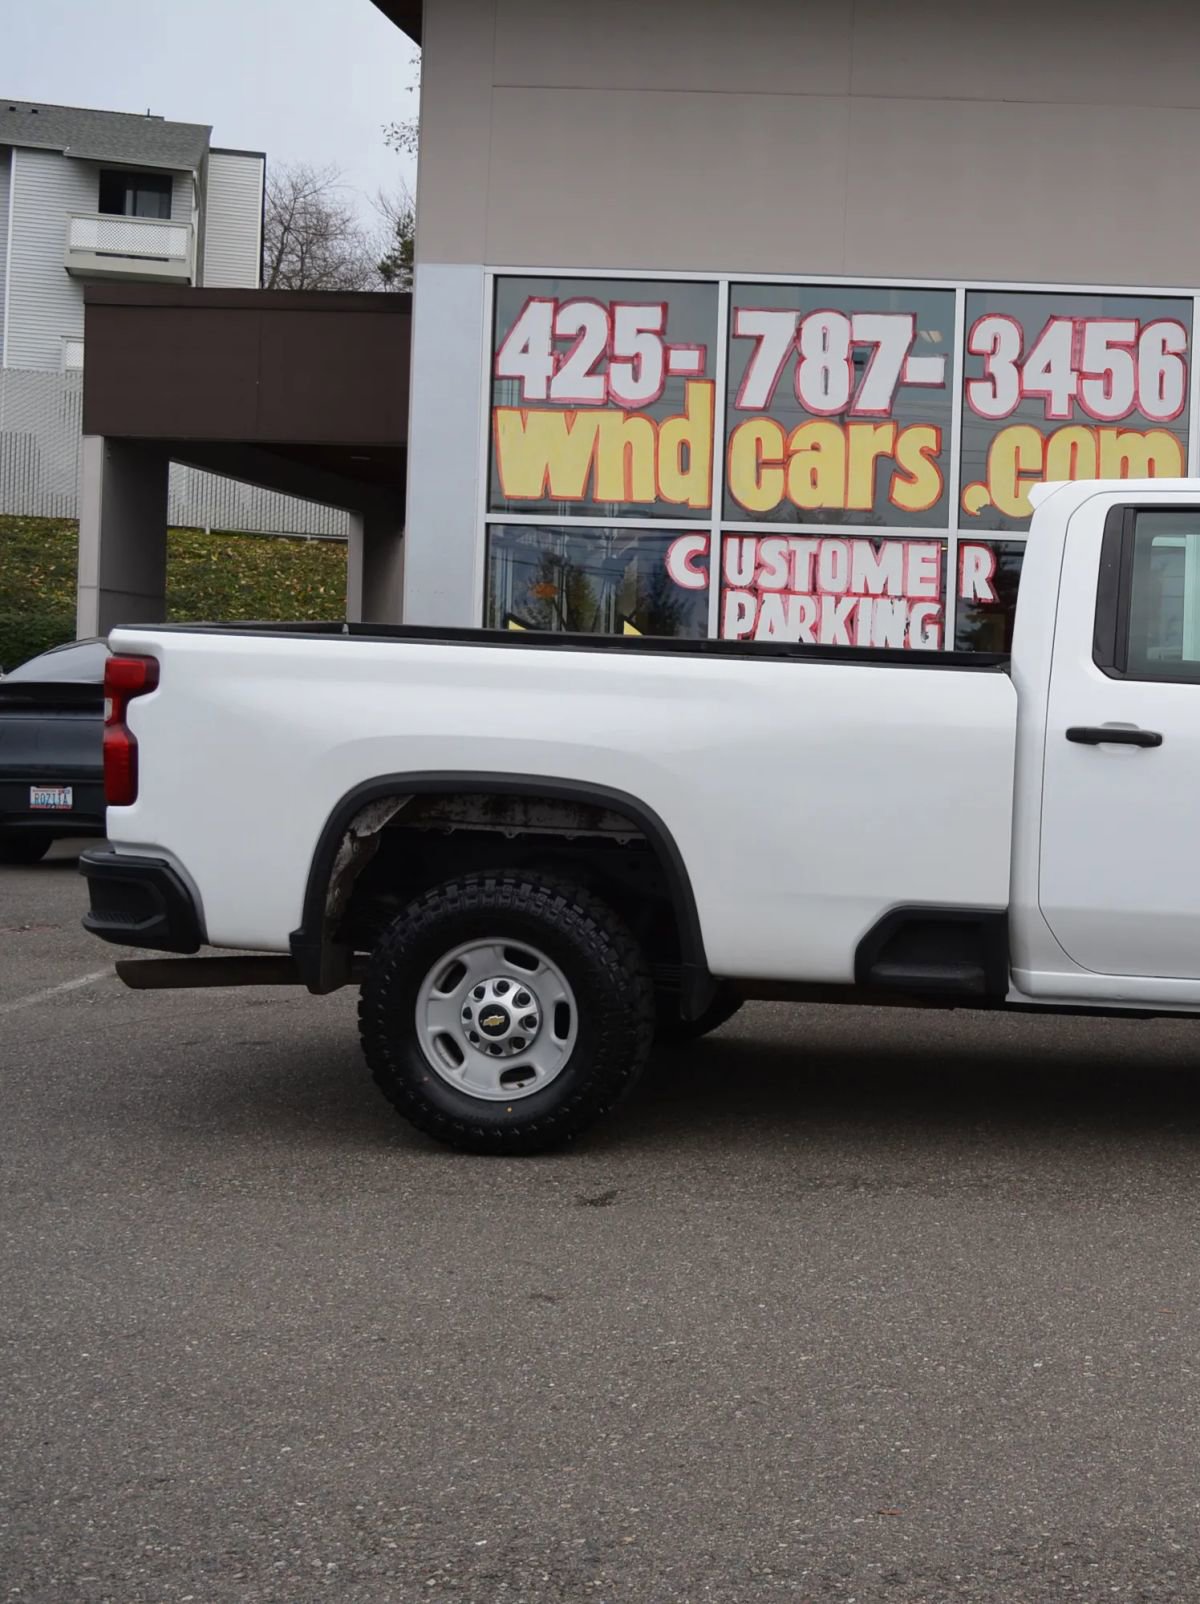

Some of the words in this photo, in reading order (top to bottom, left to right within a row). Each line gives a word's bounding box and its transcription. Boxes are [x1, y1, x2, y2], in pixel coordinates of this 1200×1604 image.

[497, 296, 707, 408] 425-
[732, 308, 947, 417] 787-
[964, 312, 1189, 421] 3456
[722, 591, 942, 650] PARKING
